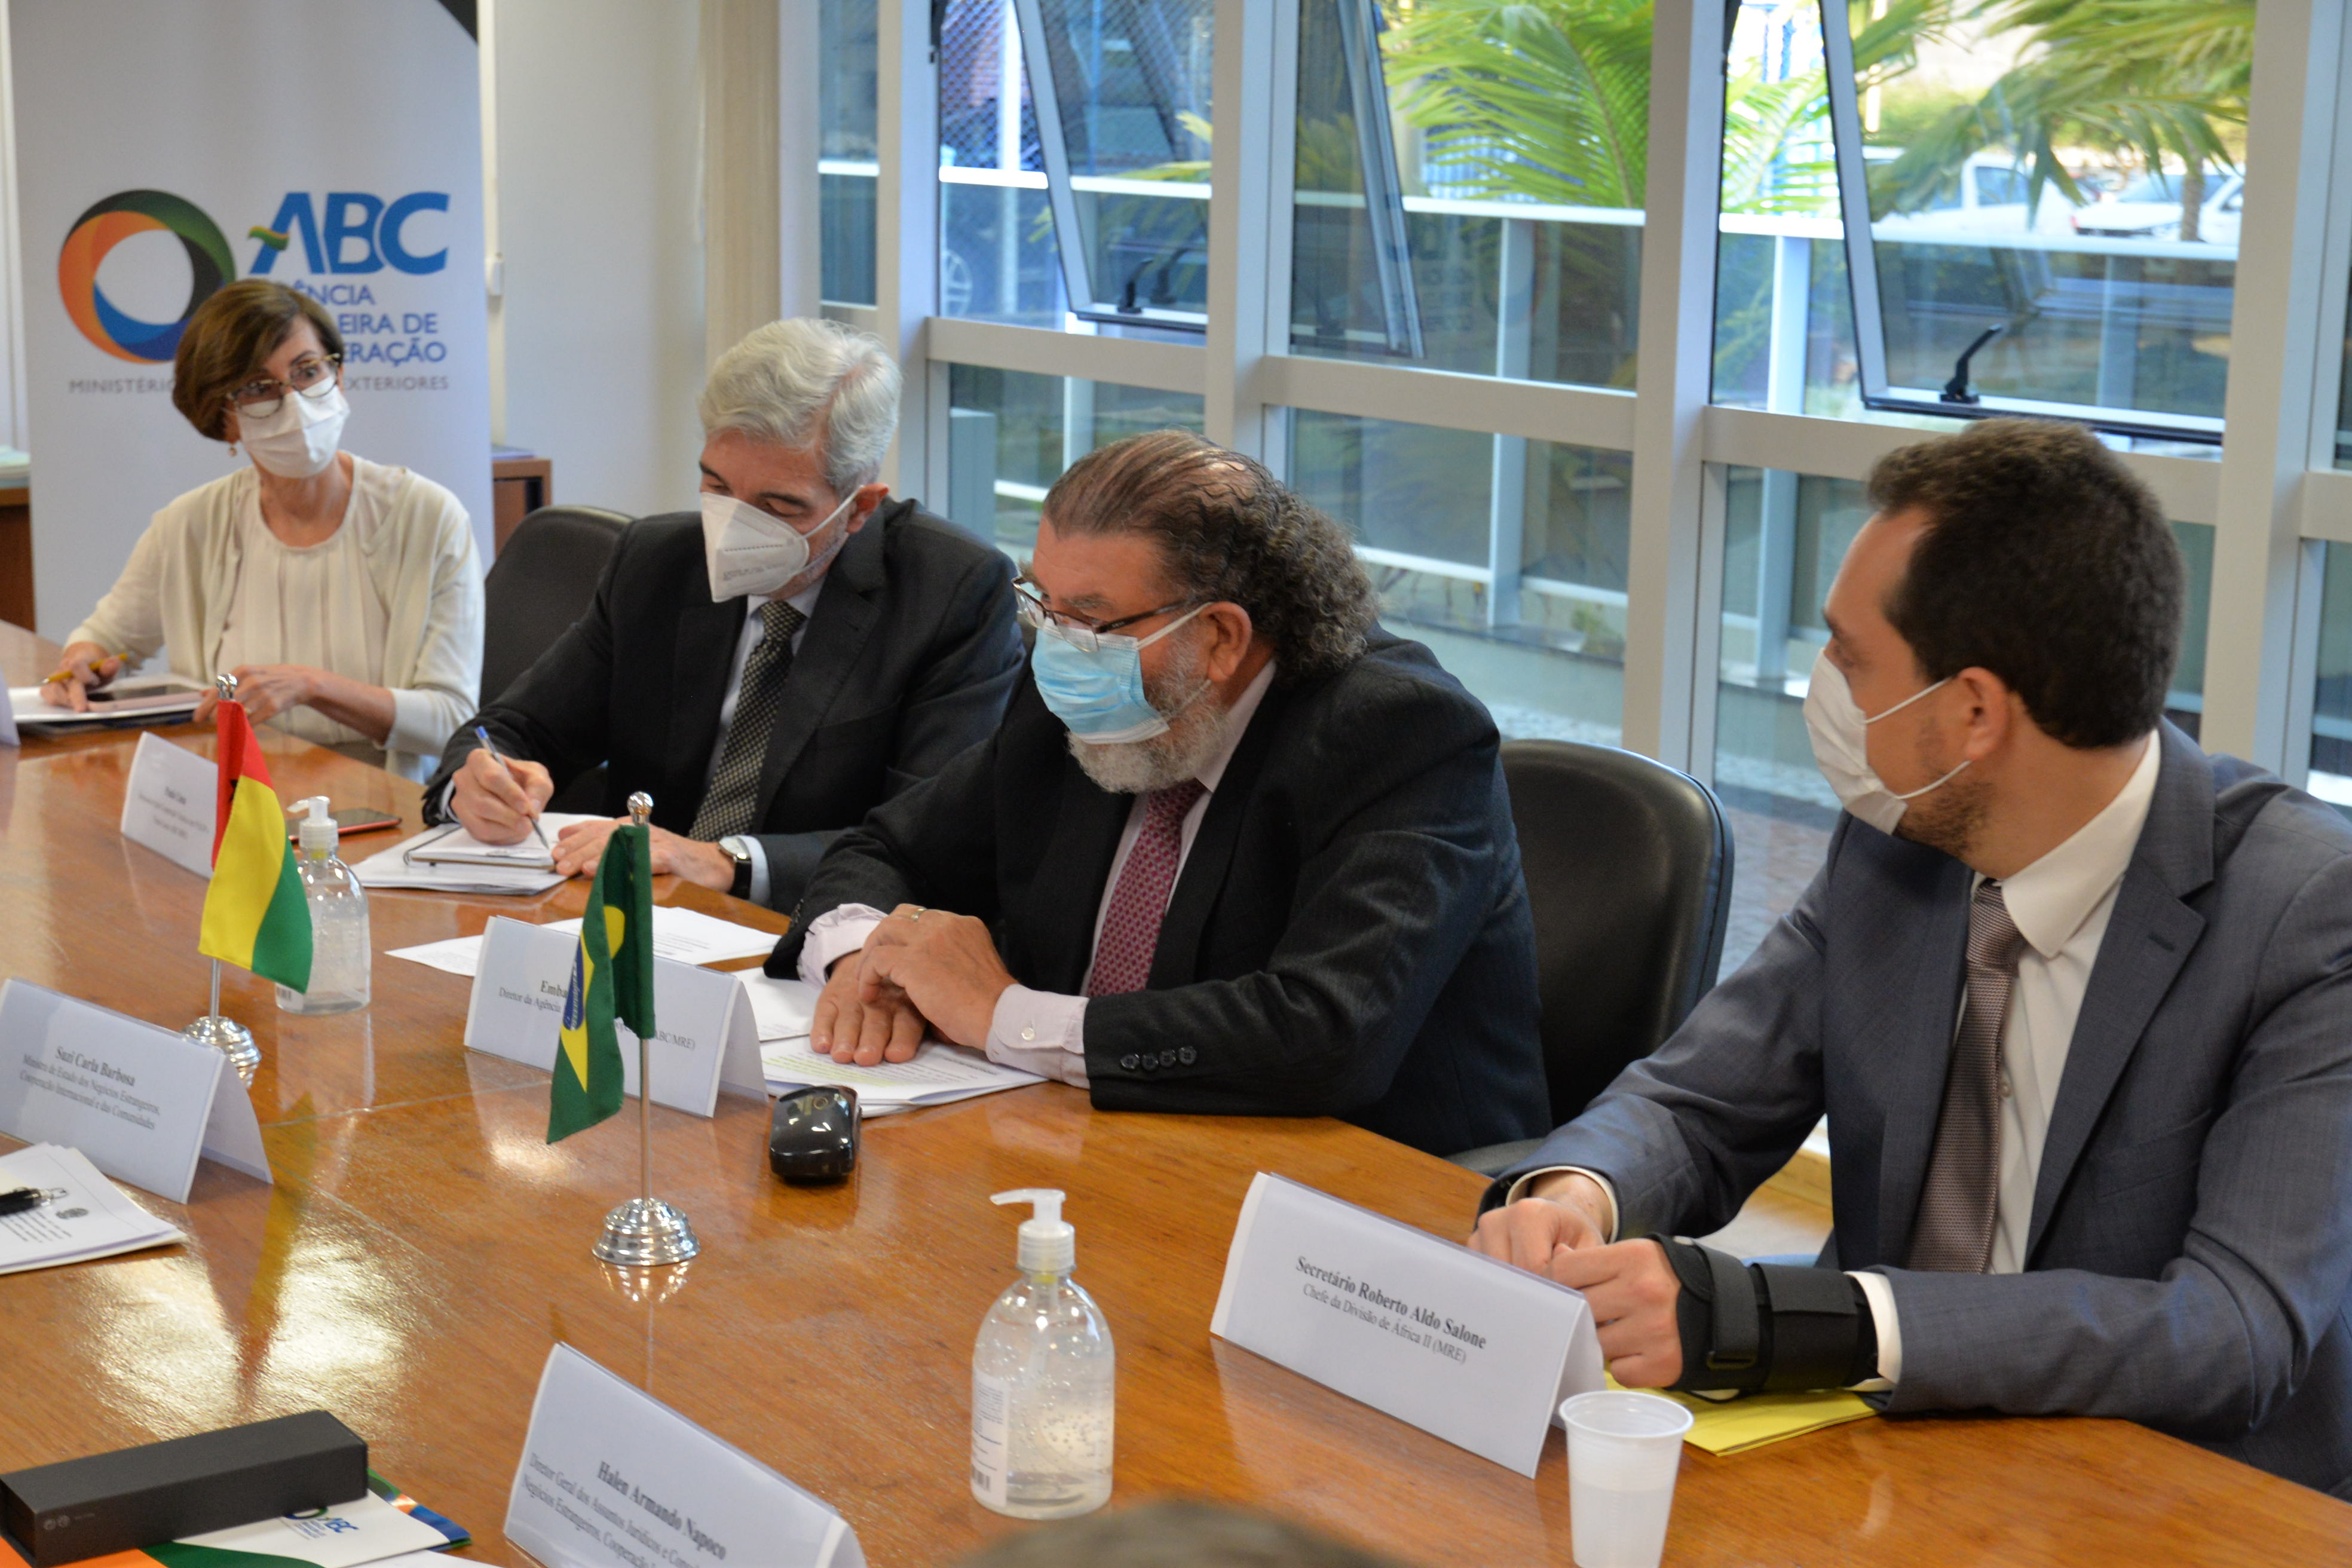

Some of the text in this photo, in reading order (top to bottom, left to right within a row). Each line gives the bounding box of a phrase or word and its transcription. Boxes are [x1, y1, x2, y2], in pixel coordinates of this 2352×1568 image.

[249, 191, 451, 276] ABC
[403, 313, 437, 333] DE
[523, 994, 532, 1005] da
[75, 1054, 99, 1073] Carla
[1296, 1256, 1487, 1349] Secretário Roberto Aldo Salone
[1303, 1283, 1467, 1365] Chefe da Divisão de África II (MRE)
[630, 1485, 682, 1531] Armando
